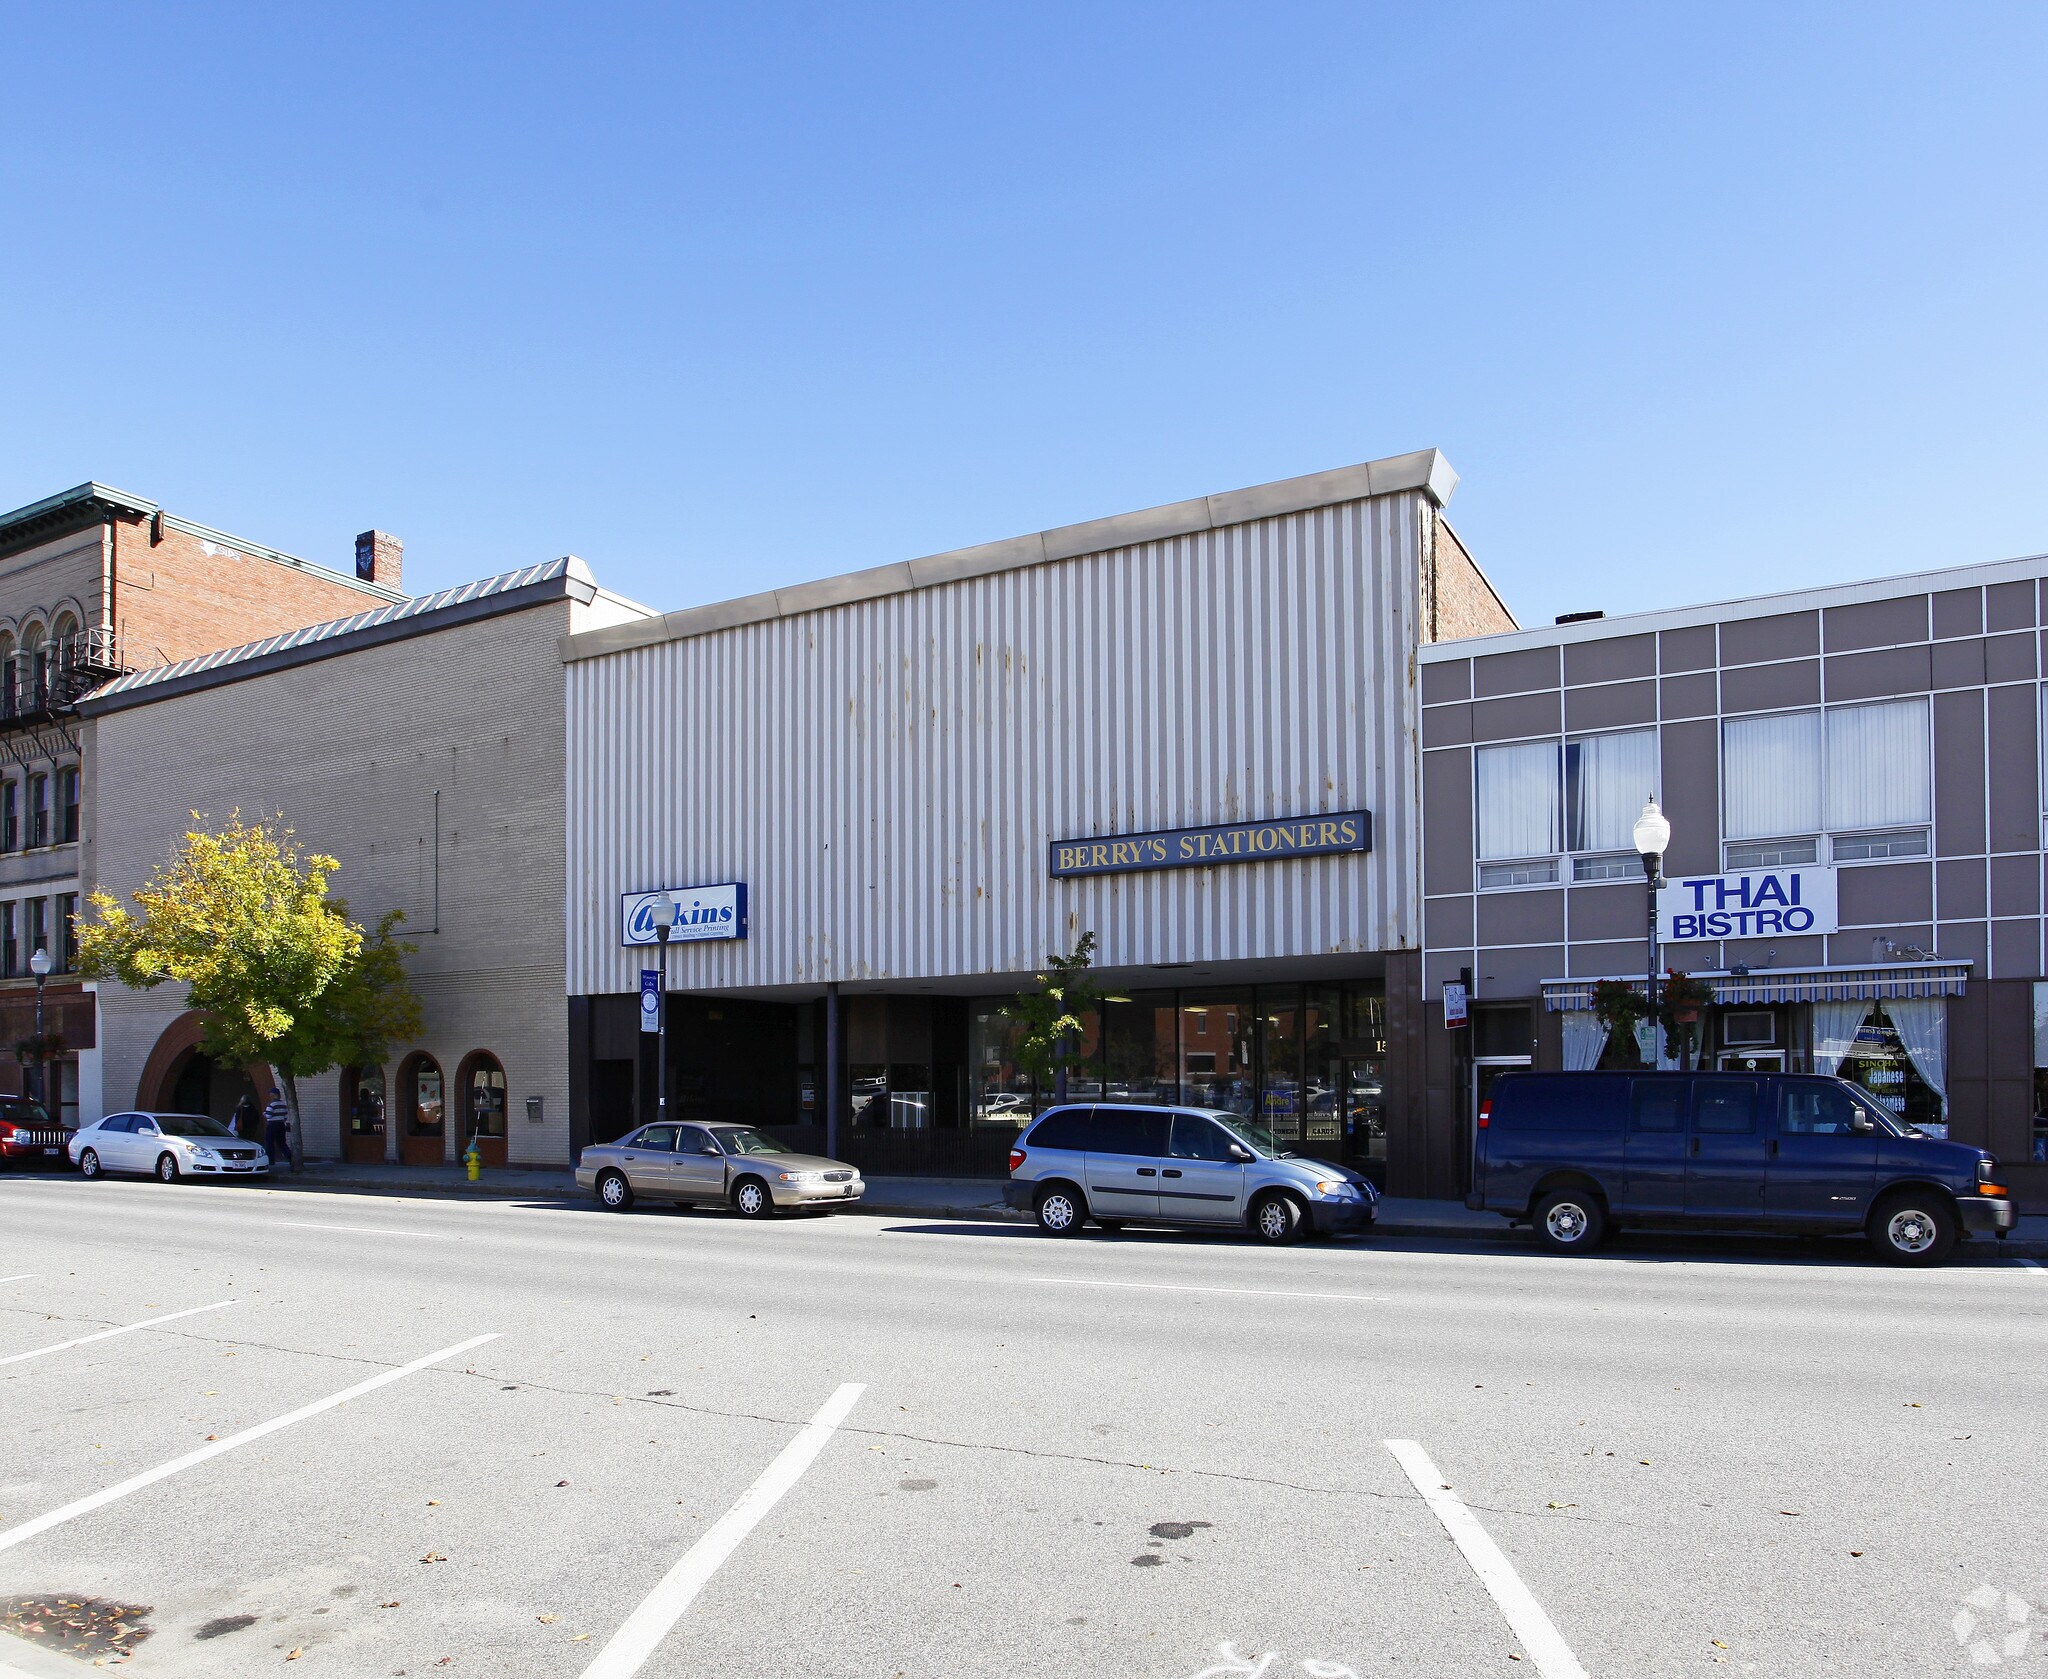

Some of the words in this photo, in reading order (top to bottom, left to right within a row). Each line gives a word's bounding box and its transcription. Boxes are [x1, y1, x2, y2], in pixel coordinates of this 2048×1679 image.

[1058, 838, 1166, 870] BERRY'S
[1179, 819, 1357, 860] STATIONERS
[1683, 873, 1800, 911] THAI
[671, 926, 680, 934] ull
[703, 924, 729, 932] Printing
[1673, 906, 1815, 939] BISTRO
[1868, 1067, 1904, 1086] Japanese
